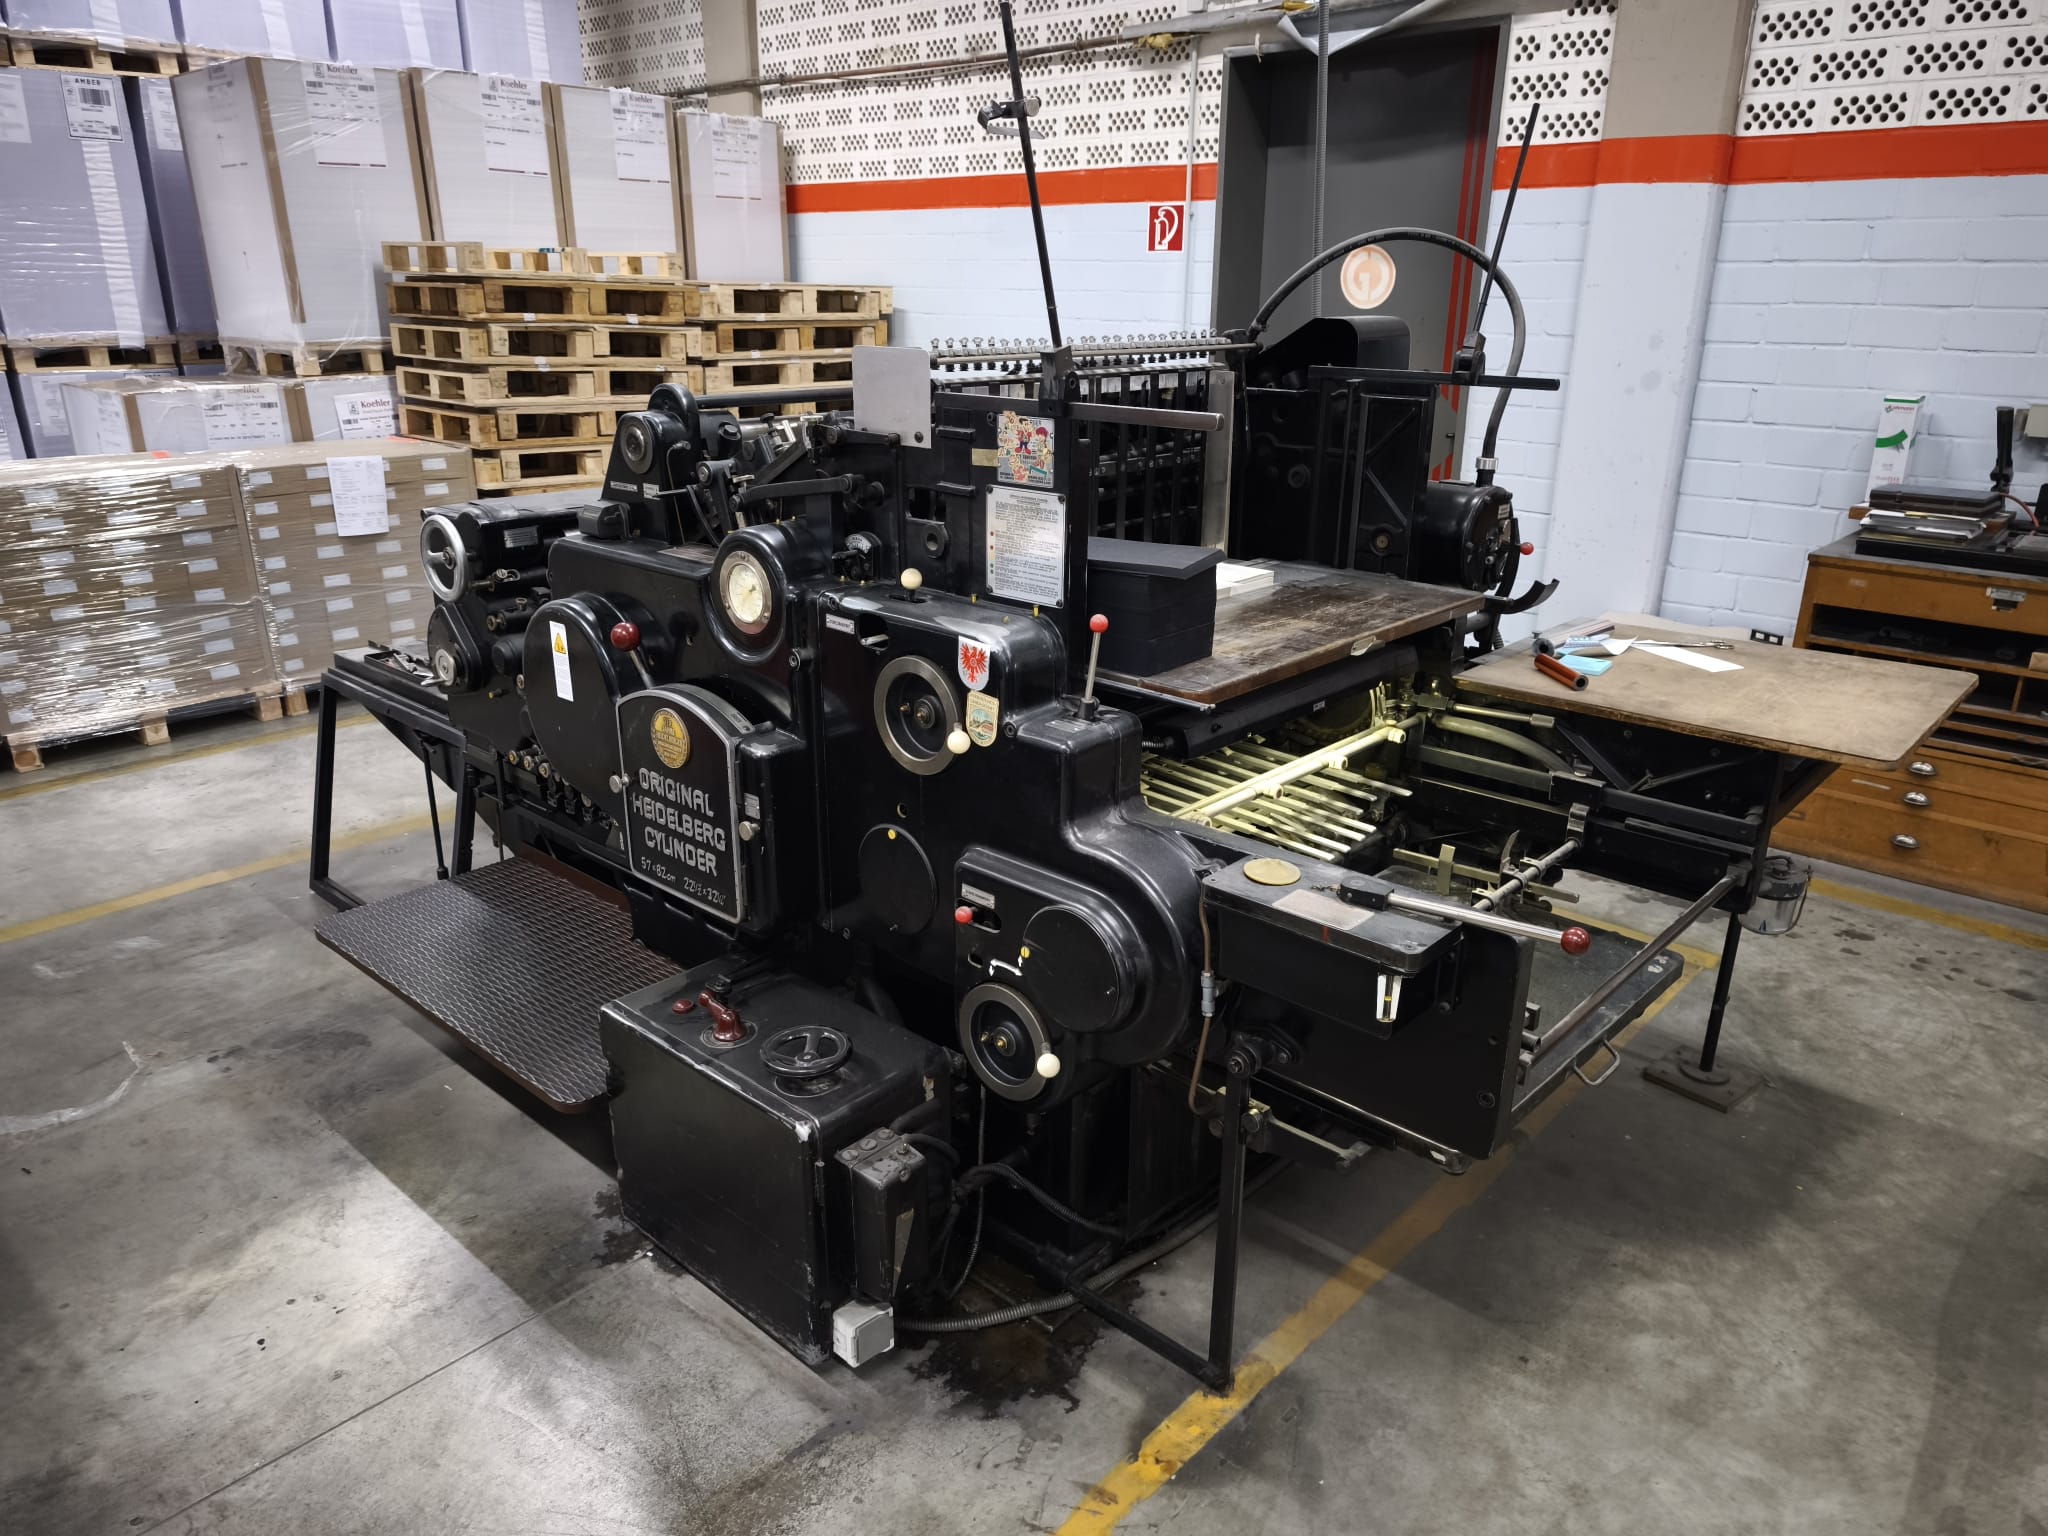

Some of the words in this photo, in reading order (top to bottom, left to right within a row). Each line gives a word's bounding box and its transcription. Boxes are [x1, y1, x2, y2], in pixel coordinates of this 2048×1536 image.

[326, 63, 358, 75] Koehler
[500, 78, 528, 90] Koehler
[360, 398, 391, 409] Koehler
[639, 767, 715, 818] ORIGINAL
[632, 791, 726, 852] HEIDELBERG
[644, 826, 718, 877] CYLINDER
